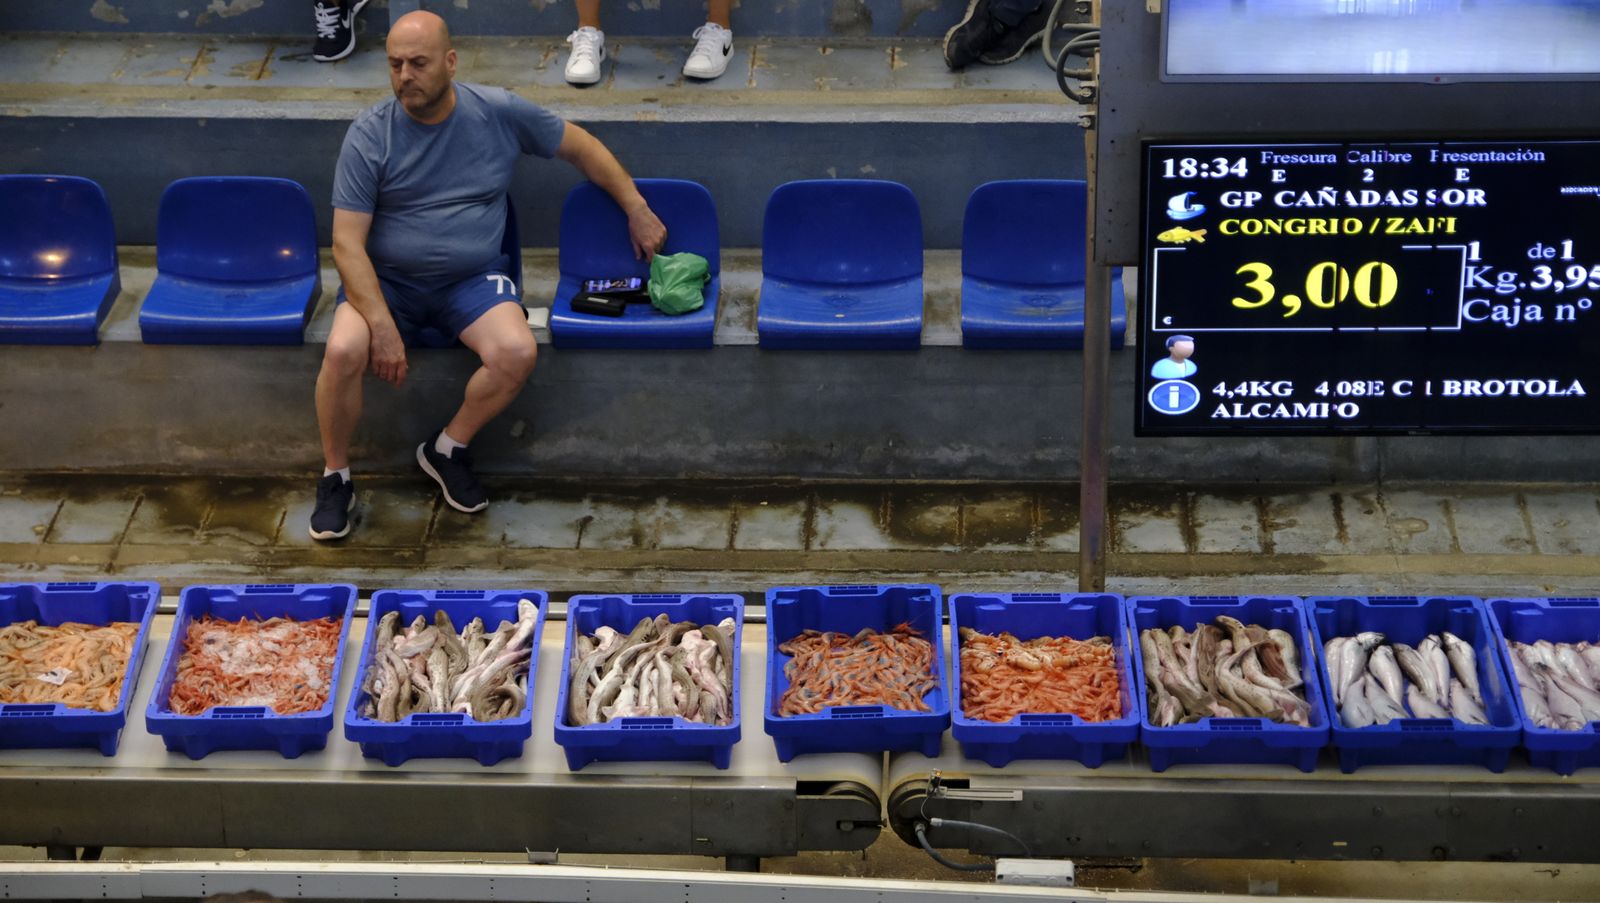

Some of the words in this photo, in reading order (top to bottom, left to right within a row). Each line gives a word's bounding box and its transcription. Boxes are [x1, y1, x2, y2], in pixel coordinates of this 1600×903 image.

[1261, 152, 1337, 164] Frescura
[1347, 150, 1412, 163] Calibre
[1430, 149, 1546, 163] Presentación
[1162, 157, 1248, 178] 18:34
[1272, 169, 1286, 182] E
[1363, 168, 1375, 182] 2
[1455, 168, 1470, 182] E
[1220, 190, 1262, 208] GP
[1274, 187, 1419, 207] CAÑADAS
[1219, 218, 1363, 234] CONGRIO
[1369, 217, 1380, 233] /
[1385, 217, 1457, 234] ZAFI
[1468, 241, 1482, 260] 1
[1527, 243, 1556, 258] de
[1561, 239, 1575, 259] 1
[1232, 262, 1398, 318] 3,00
[1463, 298, 1544, 327] Caja
[1212, 381, 1294, 398] 4,4KG
[1315, 380, 1386, 397] 408E
[1442, 379, 1586, 396] BROTOLA
